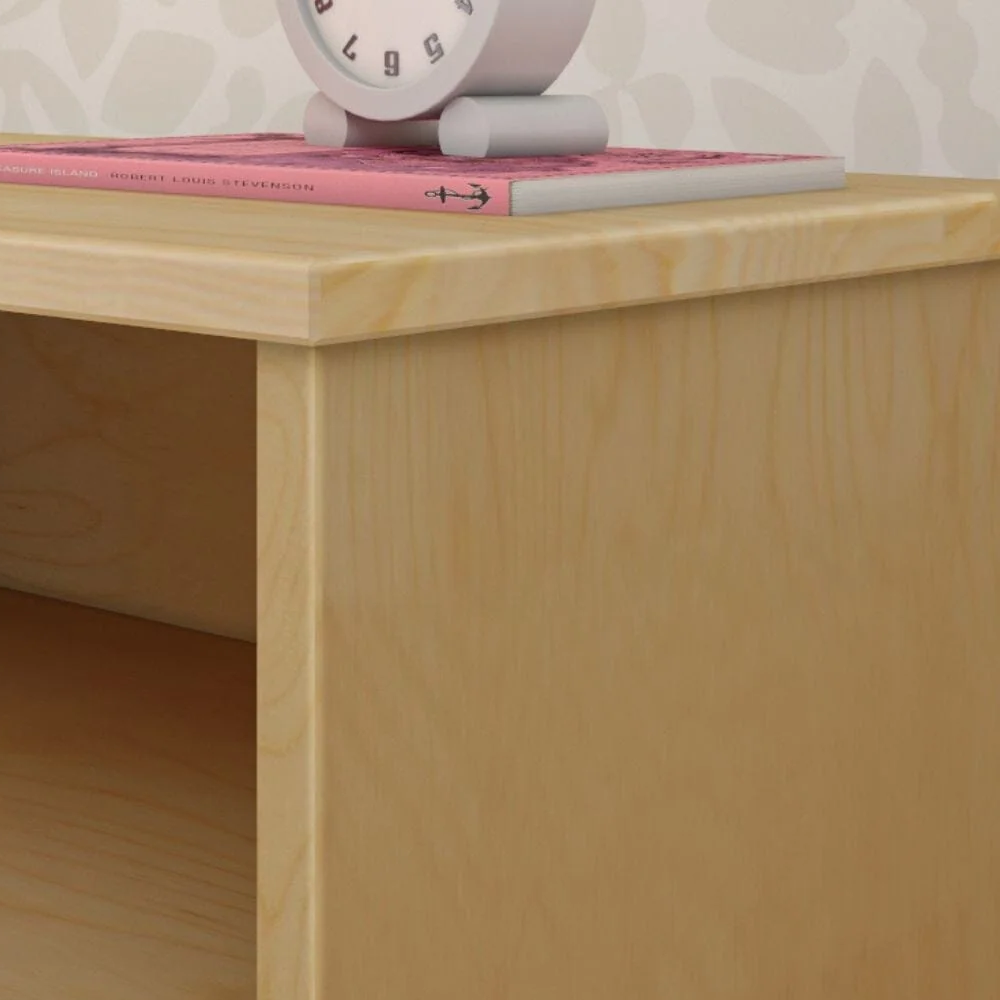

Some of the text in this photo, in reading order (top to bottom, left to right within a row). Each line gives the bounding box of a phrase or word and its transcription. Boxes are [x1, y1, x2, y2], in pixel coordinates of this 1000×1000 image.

[342, 34, 358, 61] 7
[423, 33, 445, 64] 5
[384, 51, 399, 76] 6
[50, 168, 98, 177] ISLAND
[110, 173, 165, 182] ROBERT
[172, 176, 216, 185] LOUIS
[222, 179, 315, 191] STEVENSON
